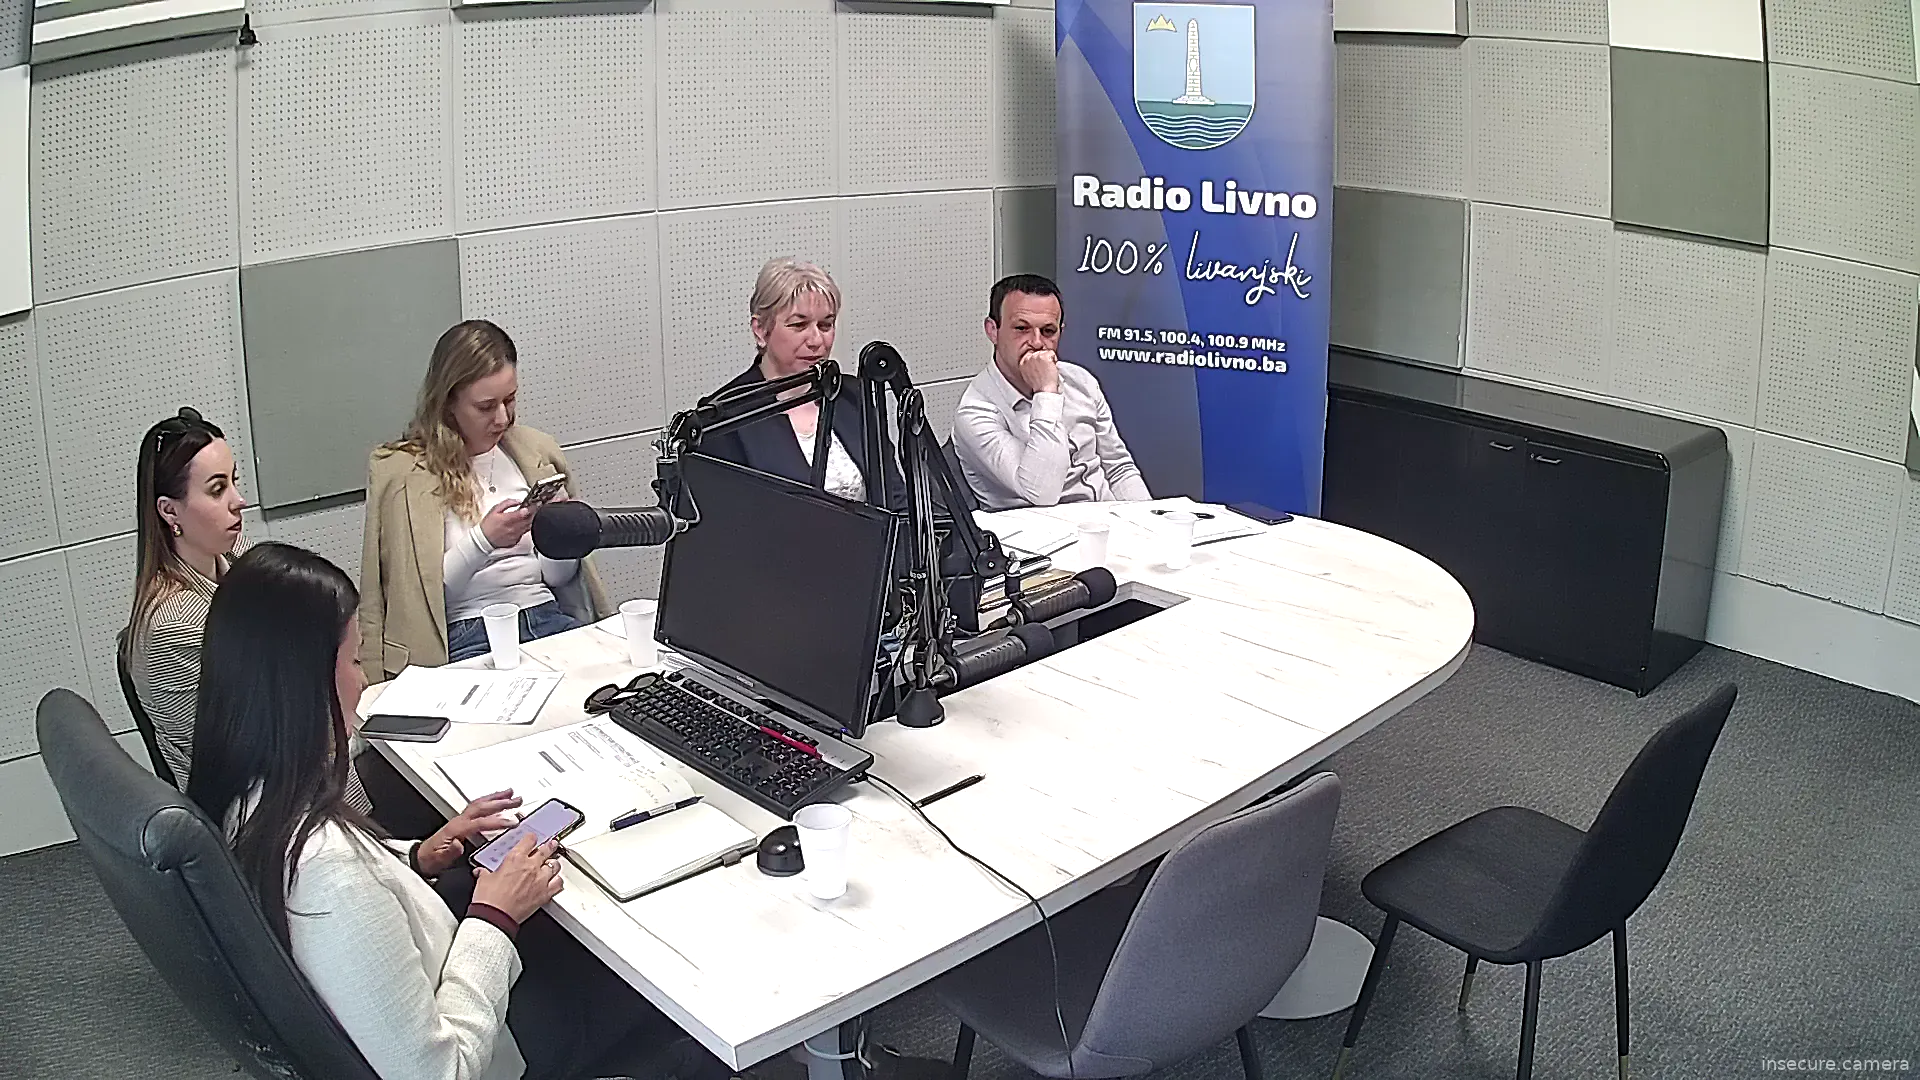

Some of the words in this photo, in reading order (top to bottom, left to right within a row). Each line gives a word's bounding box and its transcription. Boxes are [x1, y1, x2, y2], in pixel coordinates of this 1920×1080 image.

[1072, 174, 1192, 212] Radio
[1200, 180, 1318, 219] Livno
[1076, 234, 1168, 275] 100%
[1185, 230, 1313, 306] livanjski
[1098, 327, 1121, 340] FM
[1123, 328, 1157, 345] 91.5,
[1159, 331, 1205, 348] 100.4,
[1207, 334, 1249, 350] 100.9
[1251, 337, 1287, 352] MHz
[1098, 347, 1288, 373] www.radiolivno.ba
